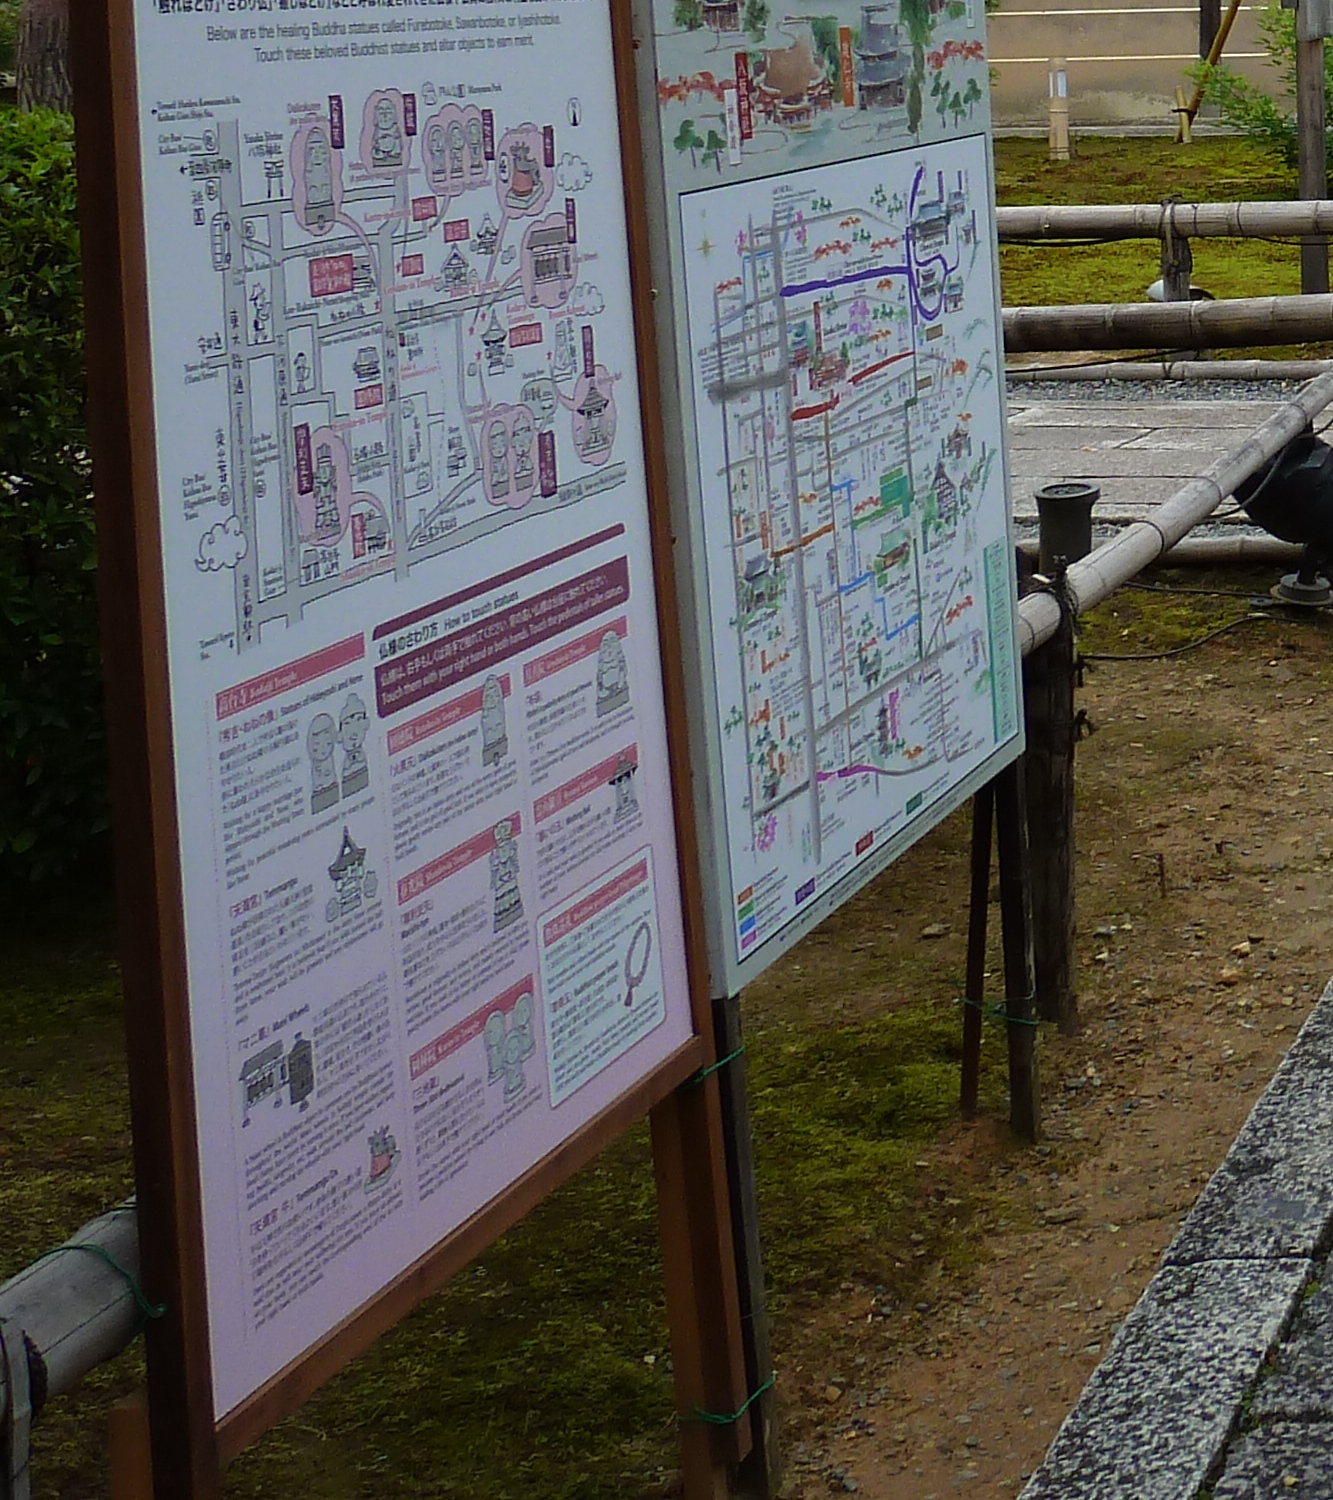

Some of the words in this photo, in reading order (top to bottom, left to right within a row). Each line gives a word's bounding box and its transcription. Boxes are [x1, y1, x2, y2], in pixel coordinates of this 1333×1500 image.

[207, 26, 237, 41] Below
[240, 28, 256, 39] are
[259, 25, 274, 38] the
[276, 23, 310, 40] healing
[312, 21, 346, 36] Buddha
[348, 23, 379, 35] statues
[254, 48, 285, 63] Touch
[286, 47, 312, 61] these
[314, 44, 348, 59] beloved
[351, 42, 388, 57] Buddhist
[391, 41, 420, 54] statues
[422, 38, 437, 52] and
[381, 684, 403, 705] Touch
